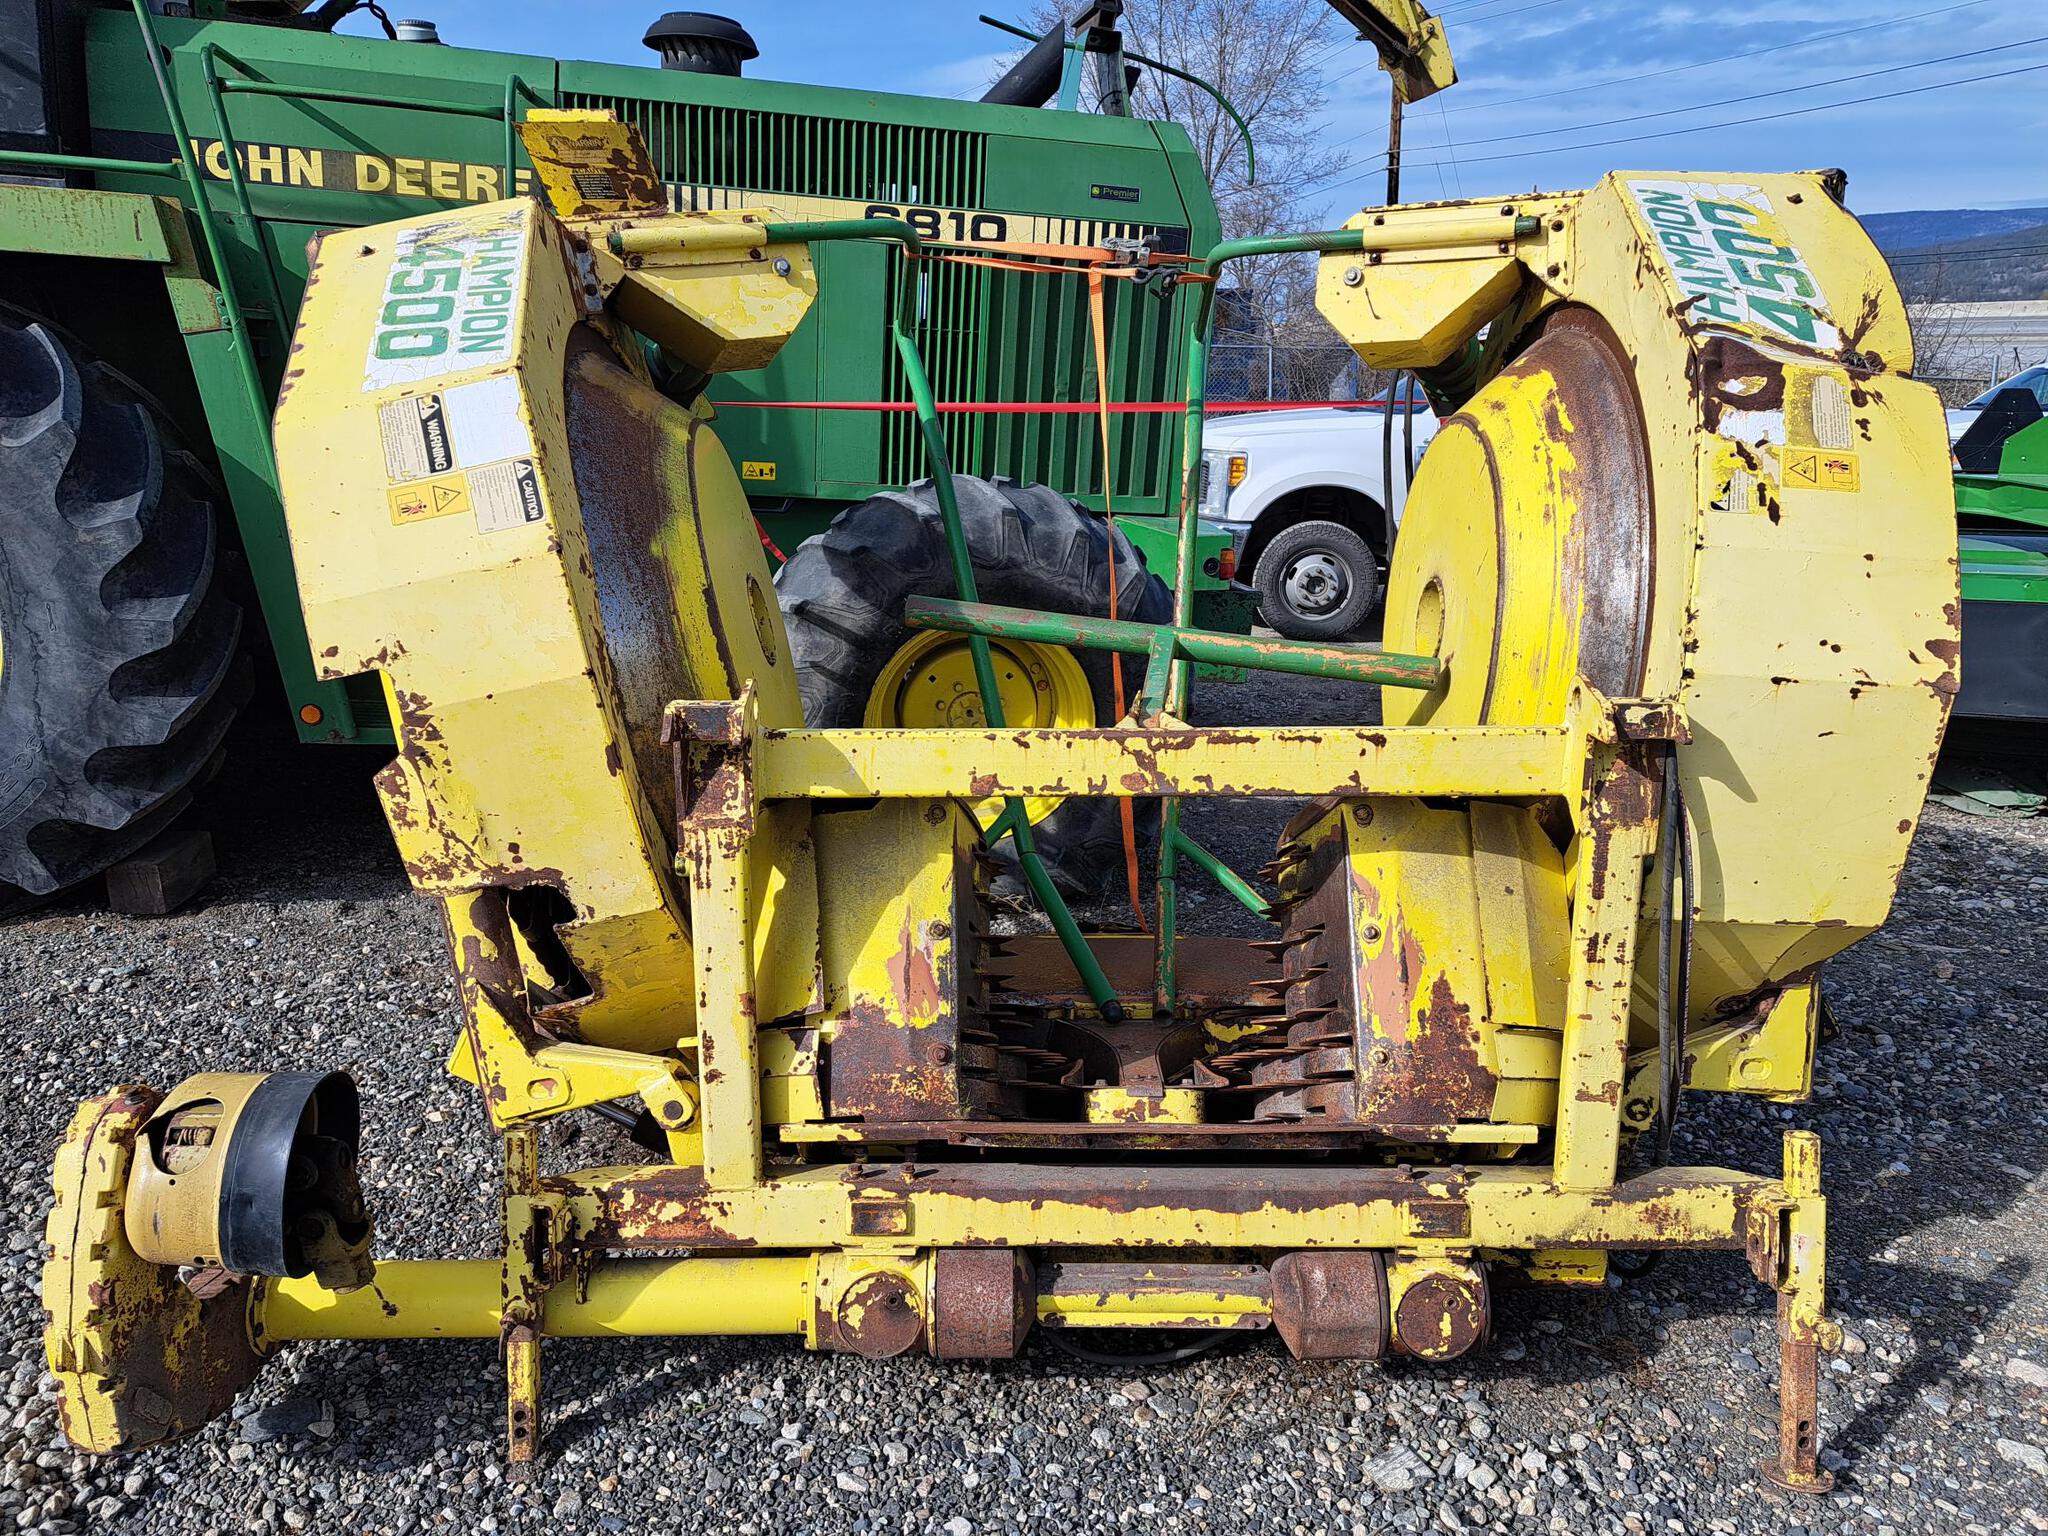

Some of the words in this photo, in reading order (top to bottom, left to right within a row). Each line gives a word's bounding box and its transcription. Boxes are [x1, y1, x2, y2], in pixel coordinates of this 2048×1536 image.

[1103, 187, 1139, 199] Premier
[458, 234, 520, 354] HAMPION
[1637, 188, 1741, 324] HAMPION
[374, 243, 467, 360] 4500
[426, 419, 449, 471] WARNING
[522, 479, 540, 523] CAUTION
